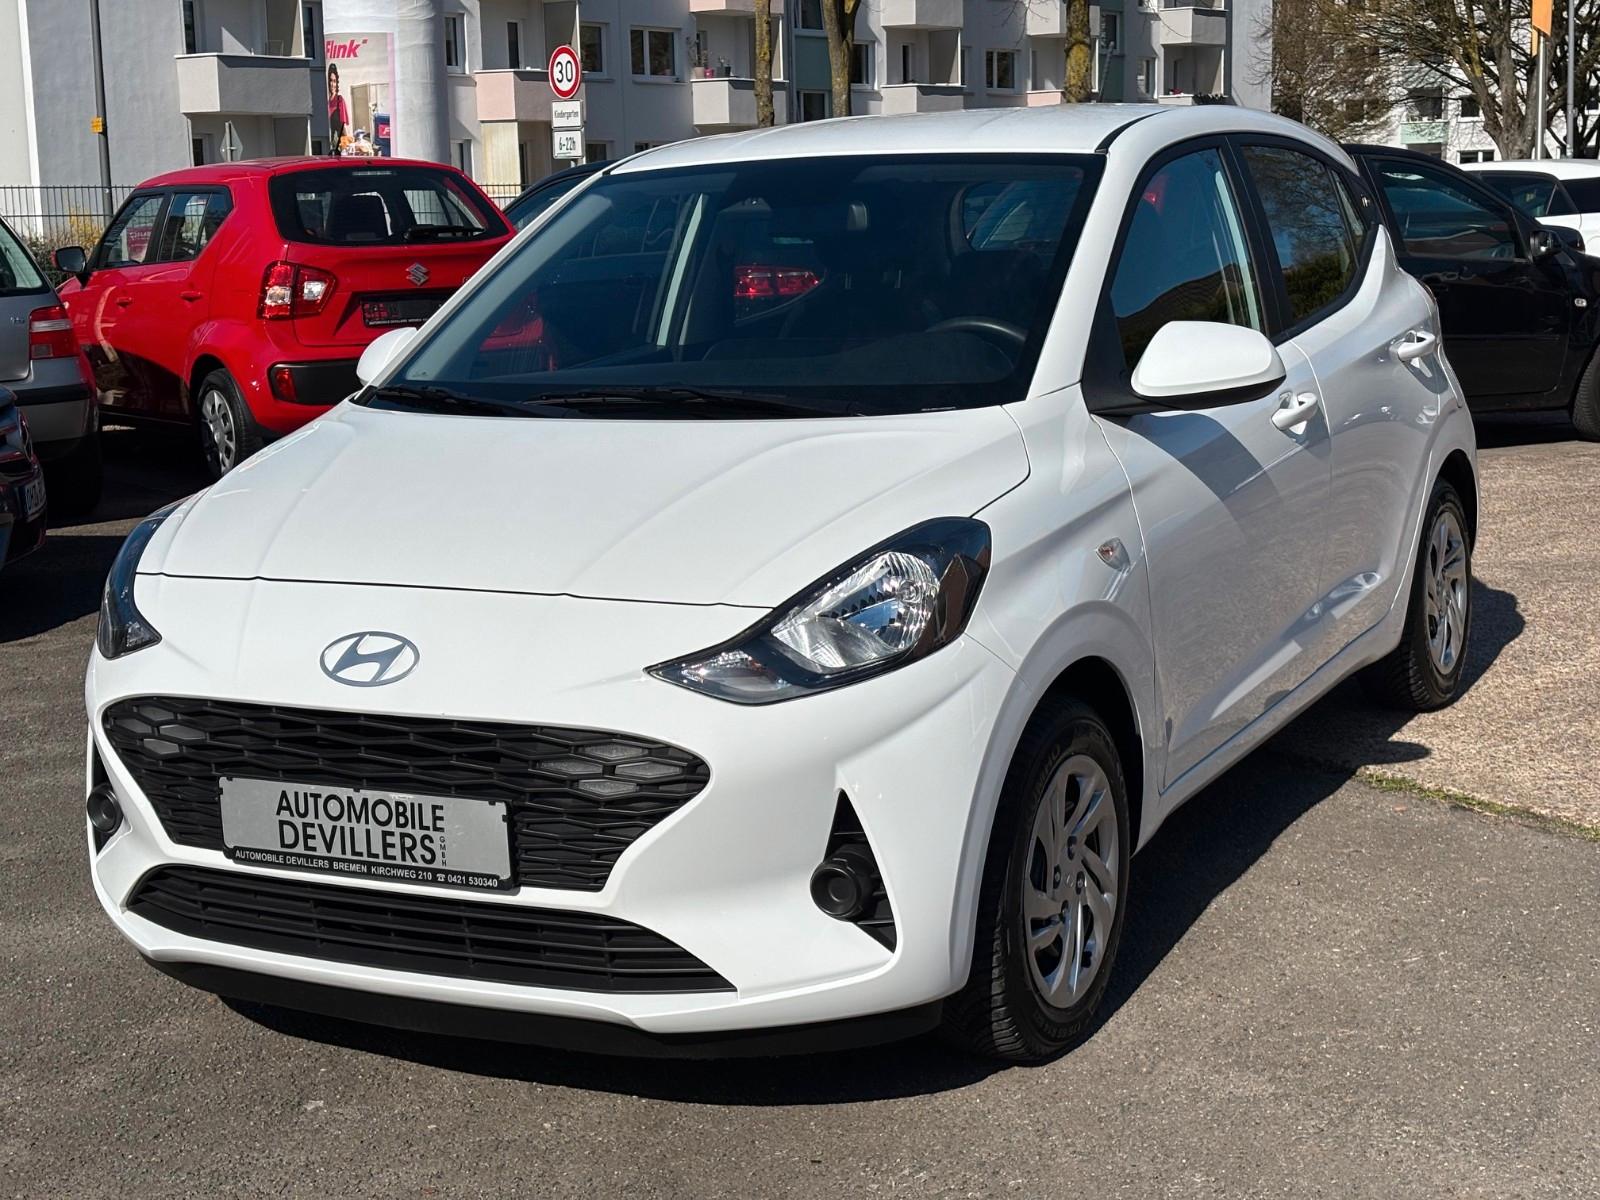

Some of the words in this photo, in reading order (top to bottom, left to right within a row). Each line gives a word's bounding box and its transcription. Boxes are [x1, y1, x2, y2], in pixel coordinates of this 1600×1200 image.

[555, 60, 574, 83] 30
[559, 136, 576, 151] 6-22h
[275, 789, 445, 833] AUTOMOBILE
[278, 819, 437, 865] DEVILLERS
[234, 849, 285, 864] AUTOMOBILE
[286, 856, 329, 869] DEVILLERS
[333, 861, 367, 873] BREMEN
[371, 865, 416, 879] KIRCHWEG
[418, 871, 432, 881] 210
[447, 875, 466, 885] 0421
[468, 878, 498, 888] 530340
